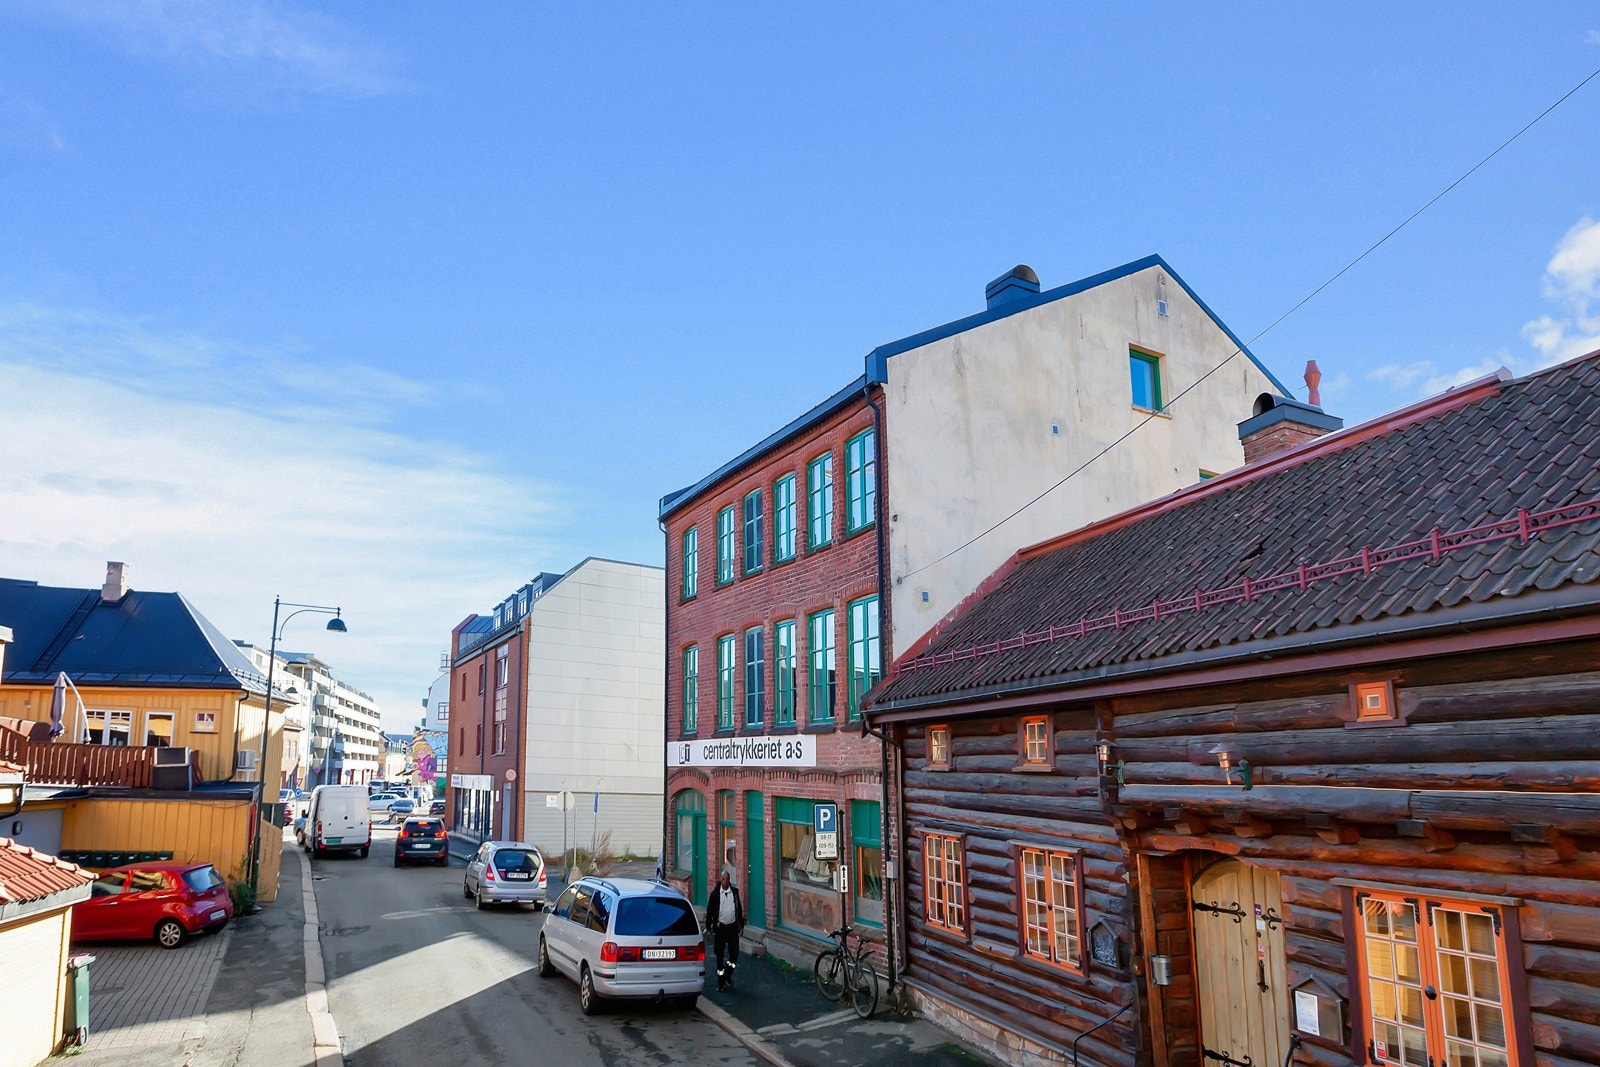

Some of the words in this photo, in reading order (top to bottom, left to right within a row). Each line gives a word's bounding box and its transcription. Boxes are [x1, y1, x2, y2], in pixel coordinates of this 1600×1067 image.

[703, 737, 782, 764] centraltrykkeriet
[820, 808, 831, 829] P
[647, 950, 656, 958] DN
[658, 950, 675, 958] 32397
